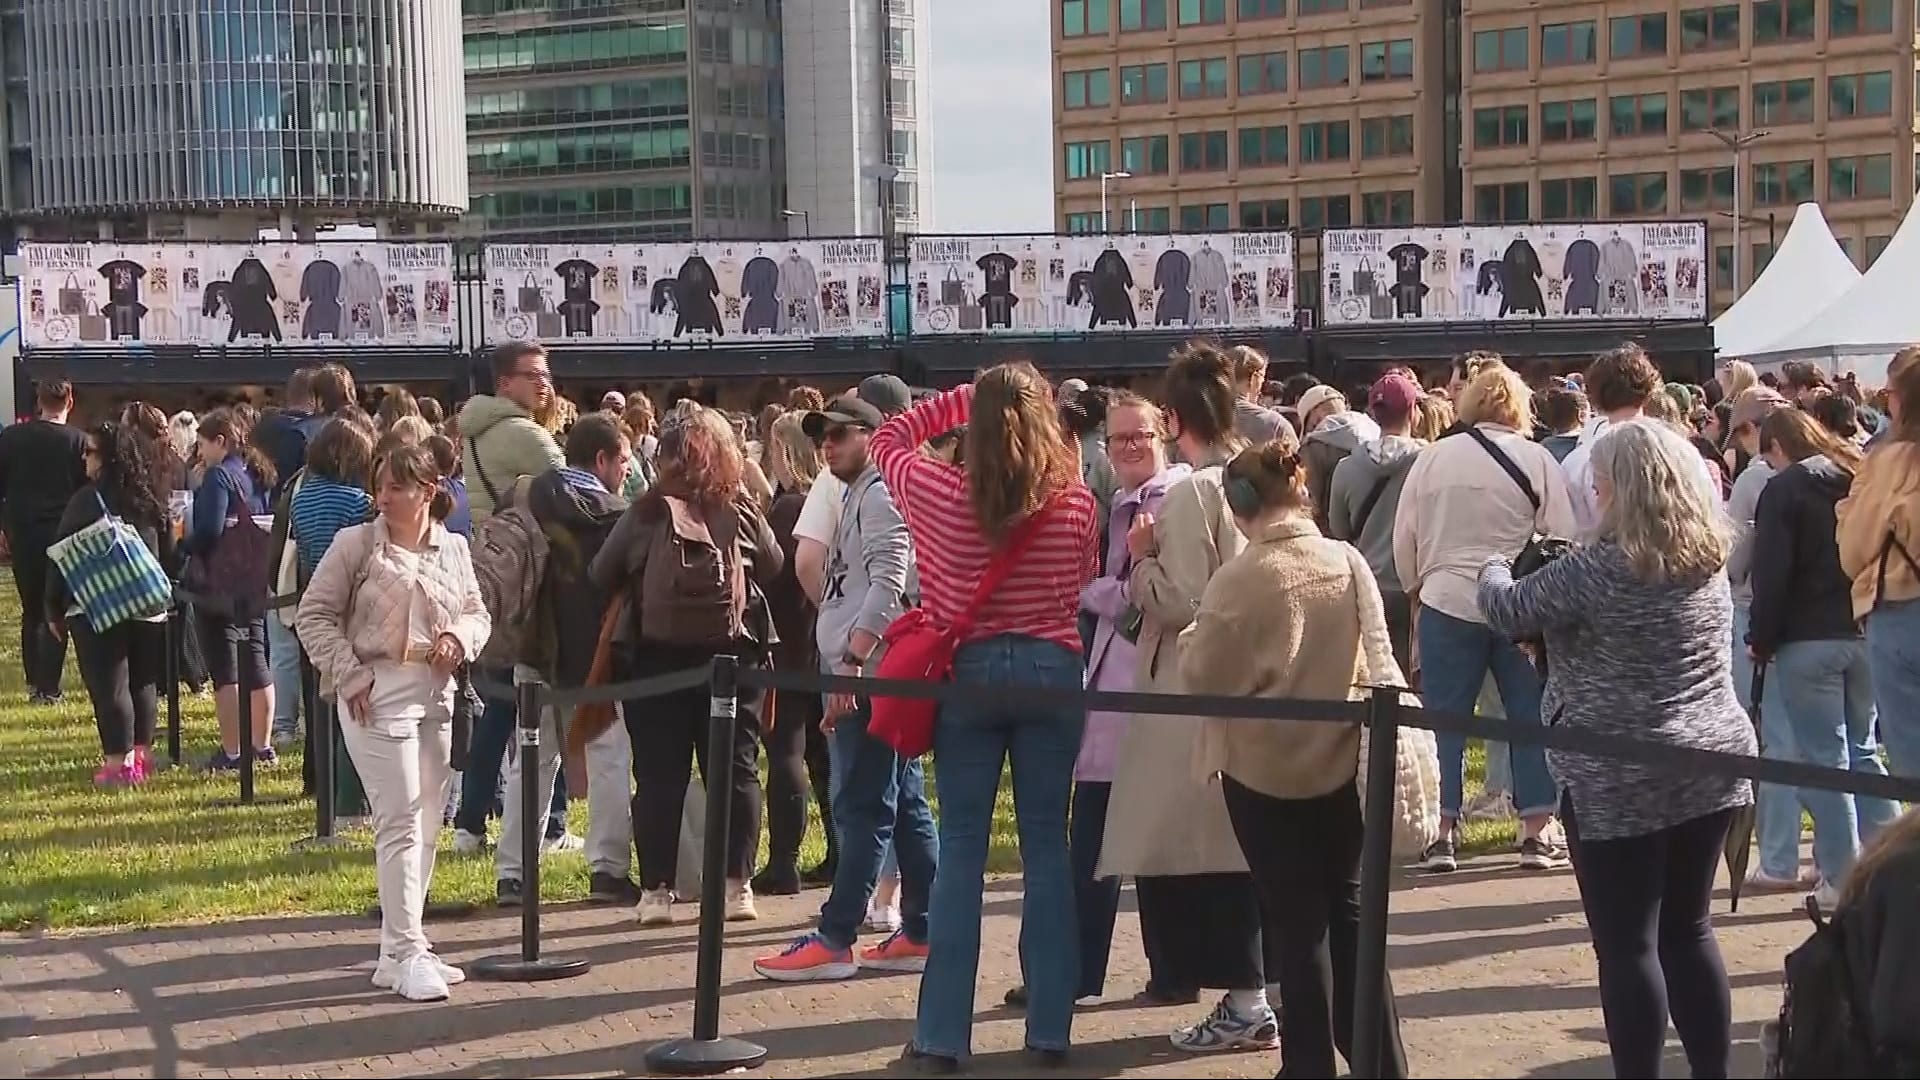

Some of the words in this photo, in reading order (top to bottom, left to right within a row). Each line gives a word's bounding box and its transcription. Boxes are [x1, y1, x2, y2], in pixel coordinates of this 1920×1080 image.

[1643, 226, 1672, 238] TAYLOR
[1673, 226, 1697, 238] SWIFT
[1232, 235, 1261, 248] TAYLOR
[1262, 235, 1287, 248] SWIFT
[1328, 233, 1358, 245] TAYLOR
[1359, 233, 1383, 245] SWIFT
[27, 247, 62, 260] TAYLOR
[64, 247, 91, 260] SWIFT
[387, 247, 418, 259] TAYLOR
[419, 247, 446, 259] SWIFT
[491, 248, 522, 260] TAYLOR
[523, 248, 549, 260] SWIFT
[822, 244, 852, 256] TAYLOR
[853, 244, 877, 256] SWIFT
[915, 242, 945, 254] TAYLOR
[946, 242, 970, 254] SWIFT
